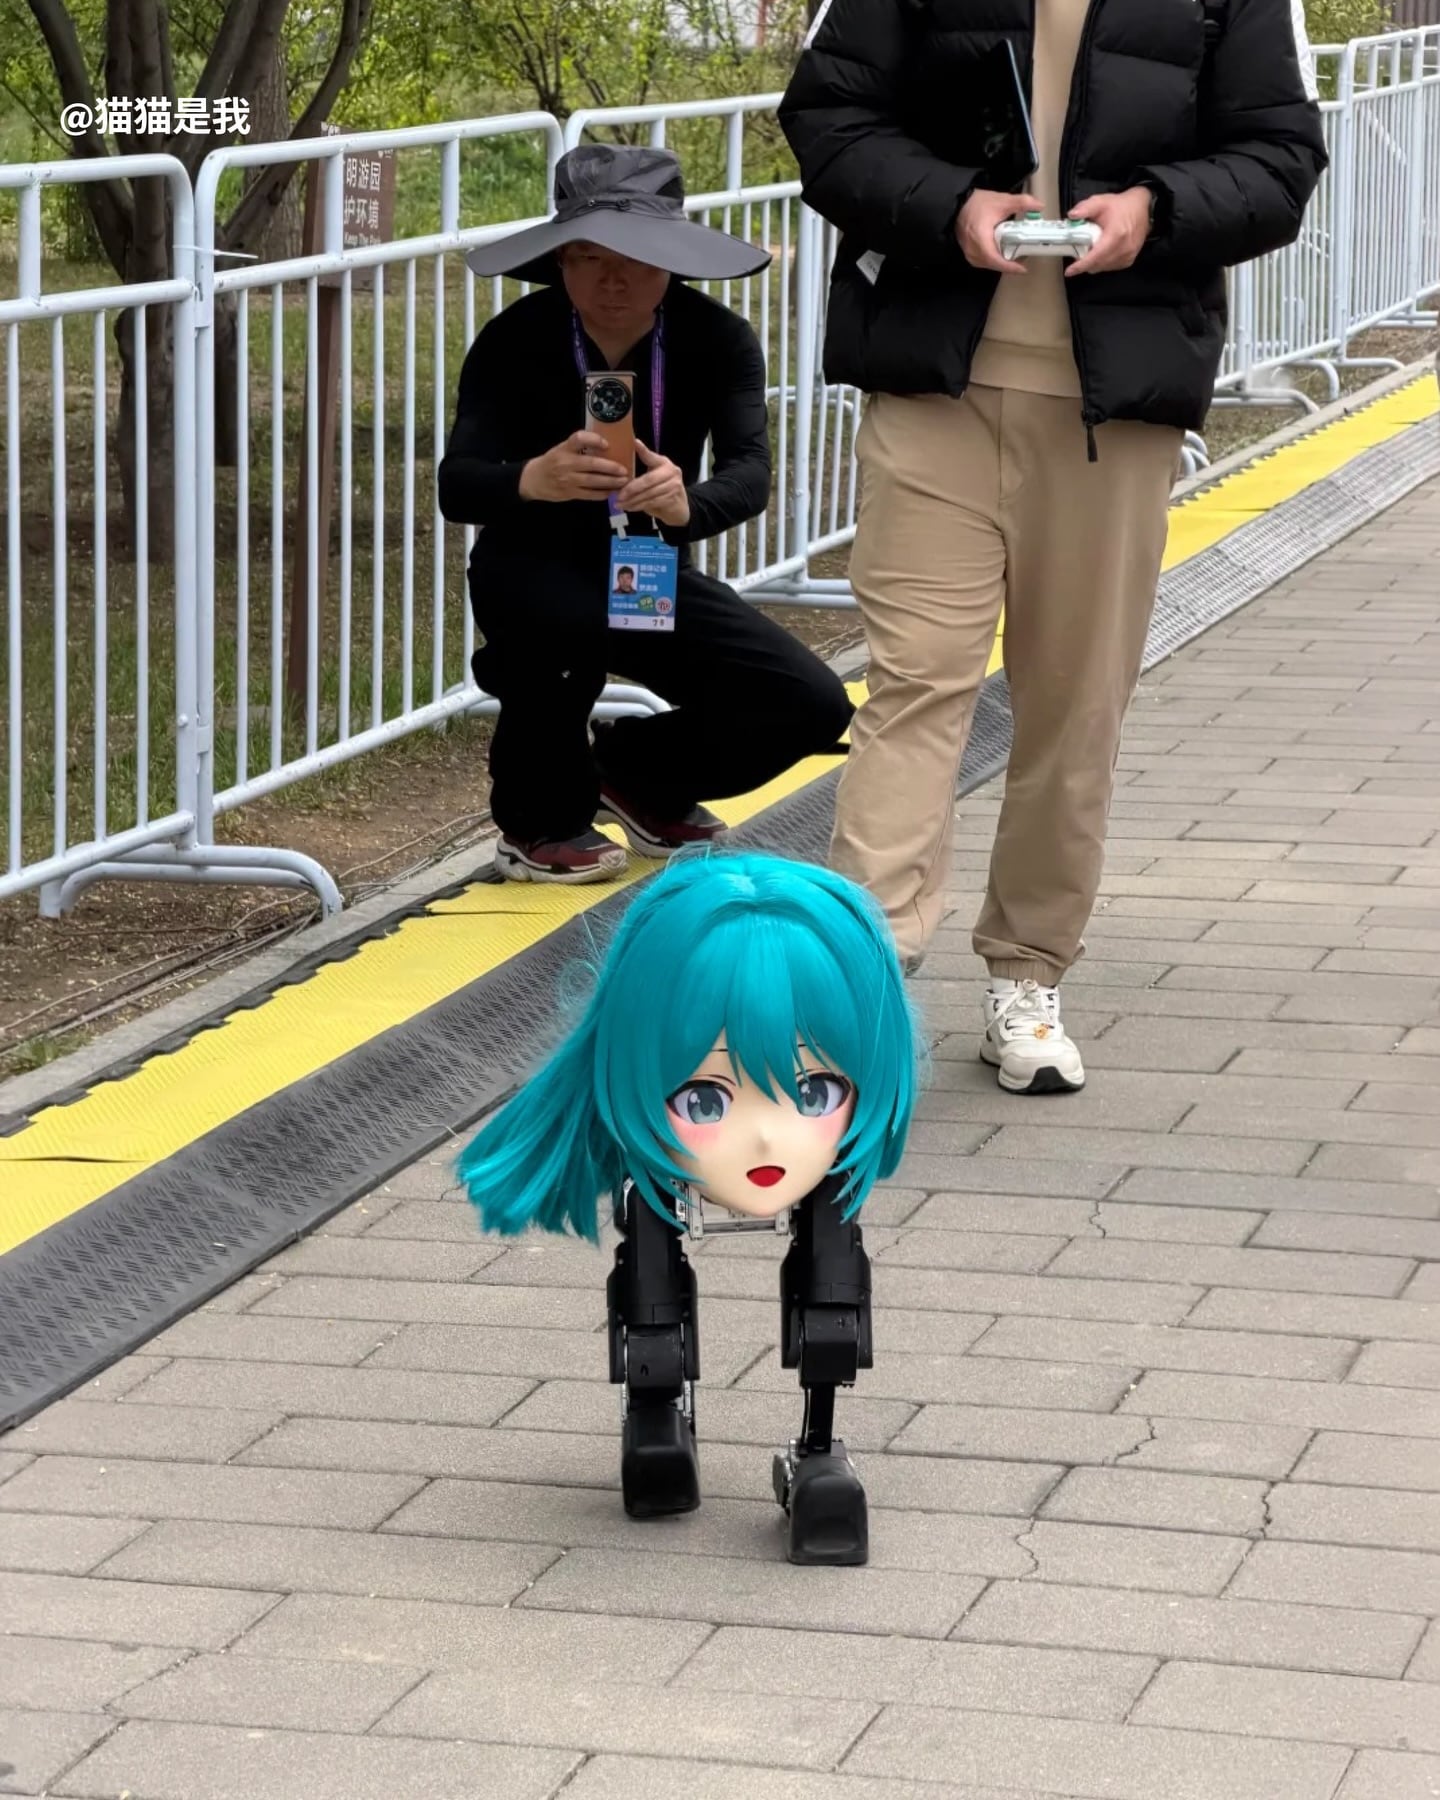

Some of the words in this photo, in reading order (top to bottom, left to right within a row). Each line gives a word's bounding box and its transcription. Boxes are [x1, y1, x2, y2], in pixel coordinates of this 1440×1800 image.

[344, 157, 381, 191] 明游园
[344, 195, 379, 229] 护环境
